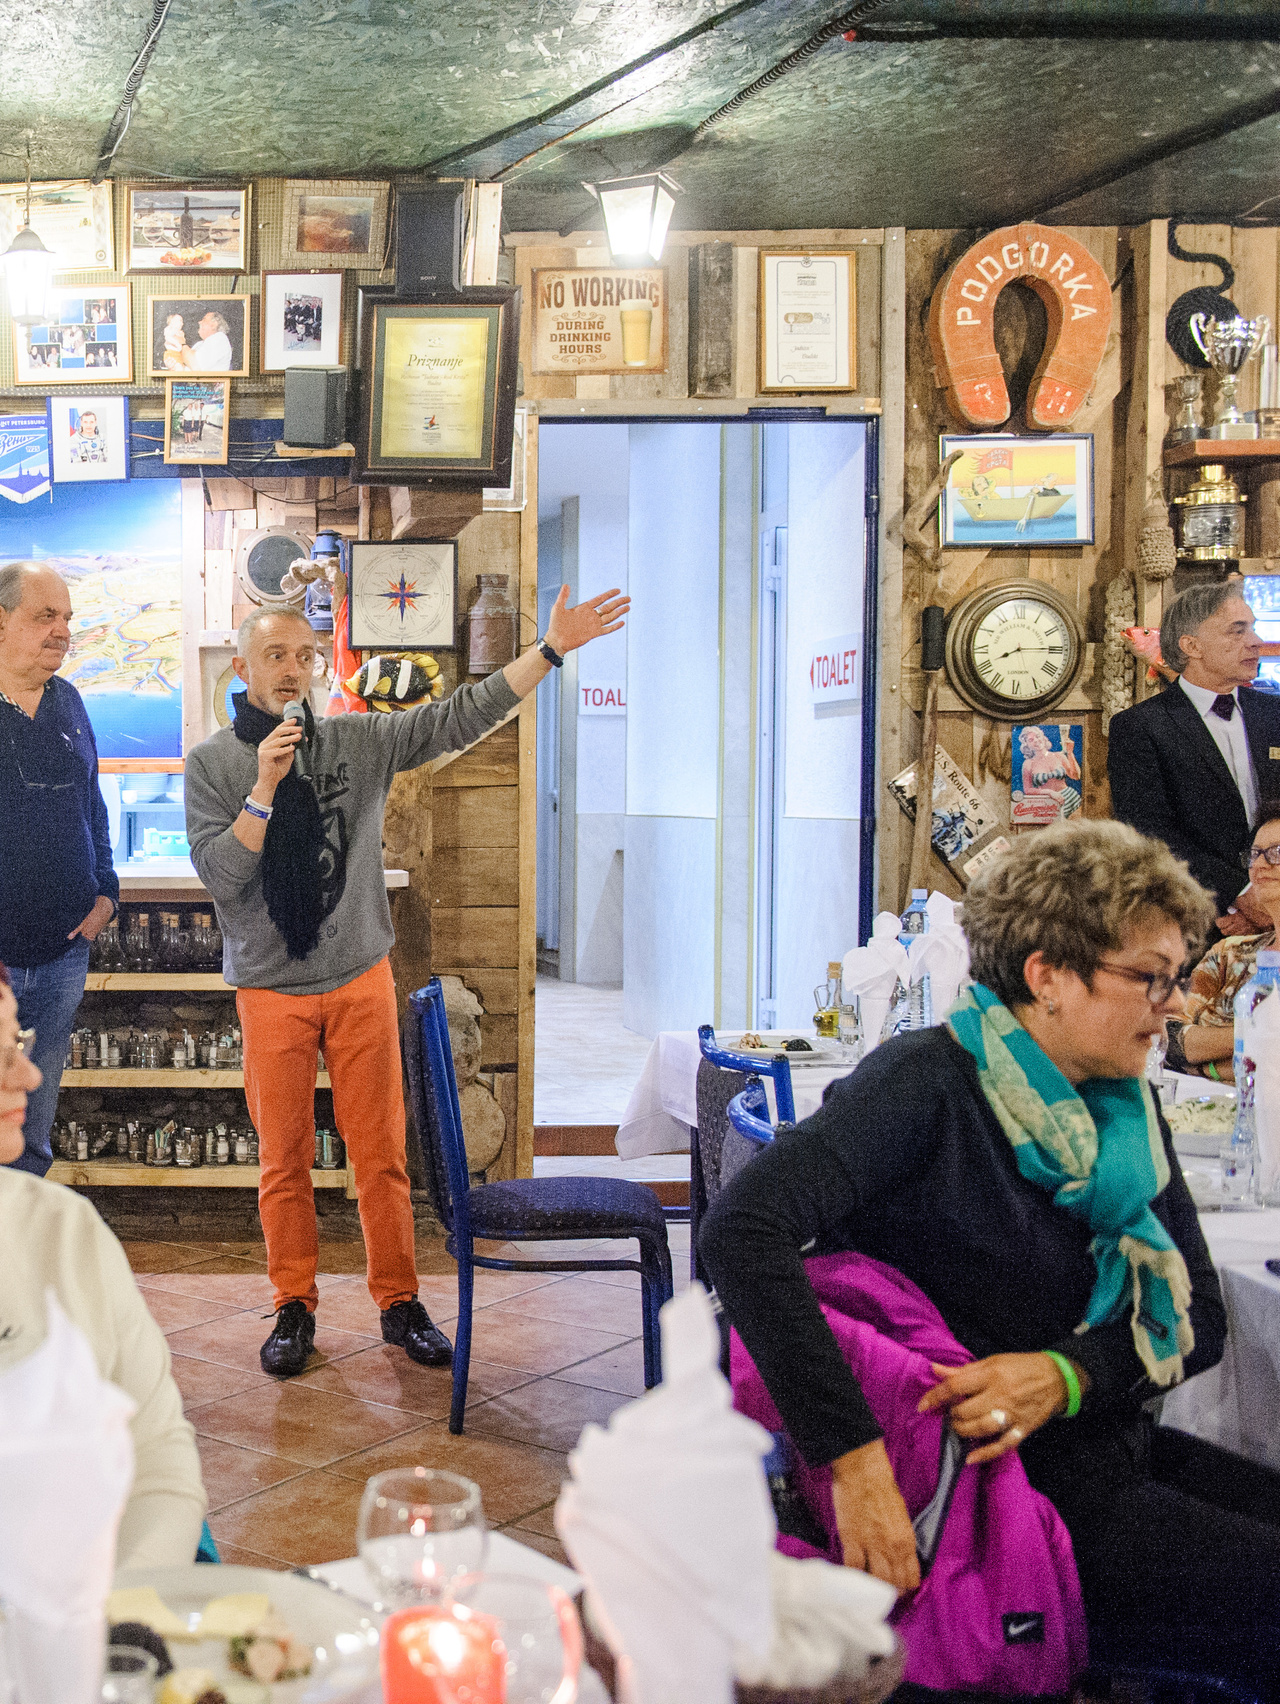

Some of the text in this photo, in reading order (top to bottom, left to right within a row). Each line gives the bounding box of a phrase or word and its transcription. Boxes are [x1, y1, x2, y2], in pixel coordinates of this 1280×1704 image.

[540, 277, 660, 309] NO WORKING
[957, 241, 1098, 326] PODGORKA
[556, 321, 604, 330] DURING
[550, 332, 611, 342] DRINKING
[559, 345, 602, 354] HOURS
[407, 354, 464, 370] Priznanje
[1000, 623, 1025, 635] WILLIAM
[1032, 628, 1044, 646] SMITH
[816, 649, 857, 688] TOALET
[582, 688, 626, 706] TOAL
[948, 770, 970, 799] Route
[969, 797, 981, 810] 66
